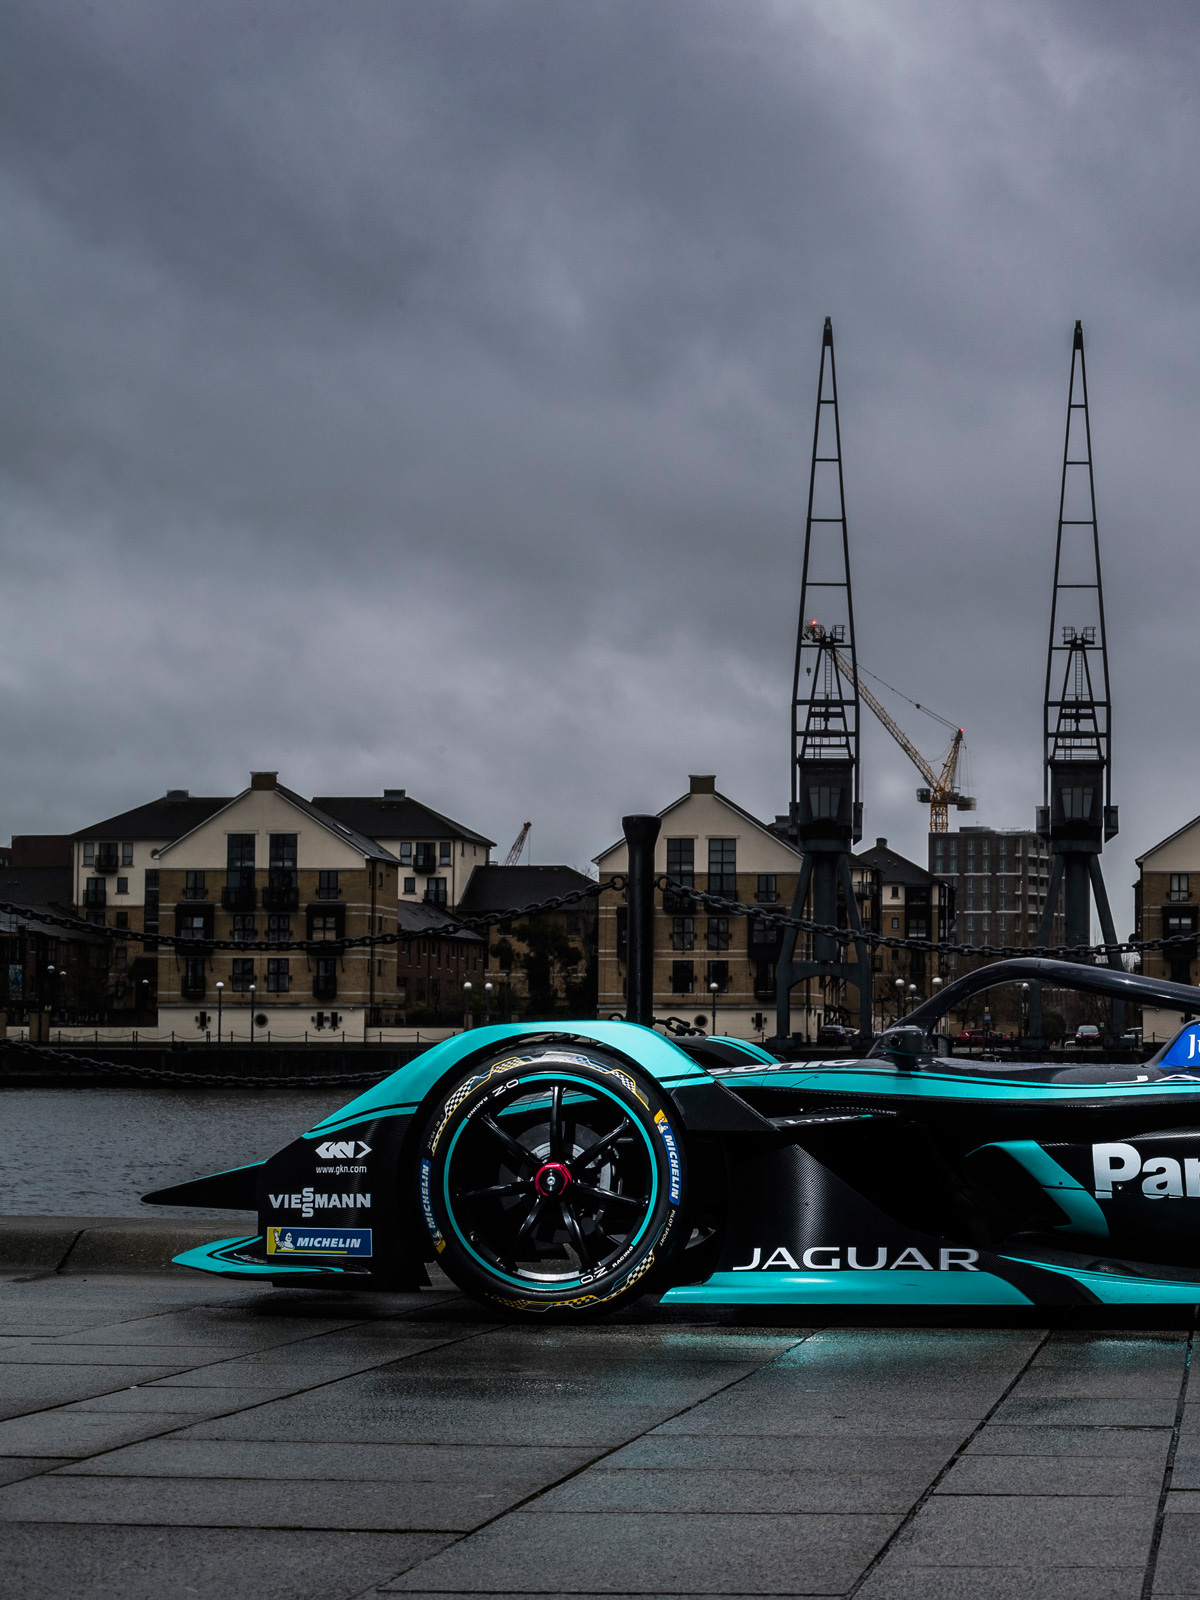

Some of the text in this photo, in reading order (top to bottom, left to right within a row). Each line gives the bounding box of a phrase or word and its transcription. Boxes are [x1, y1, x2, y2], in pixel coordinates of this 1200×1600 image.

[315, 1164, 367, 1175] www.gkn.com
[663, 1134, 680, 1200] MICHELIN
[421, 1164, 436, 1229] MICHELIN
[296, 1237, 361, 1248] MICHELIN
[659, 1226, 670, 1247] SPORT
[732, 1246, 981, 1271] JAGUAR
